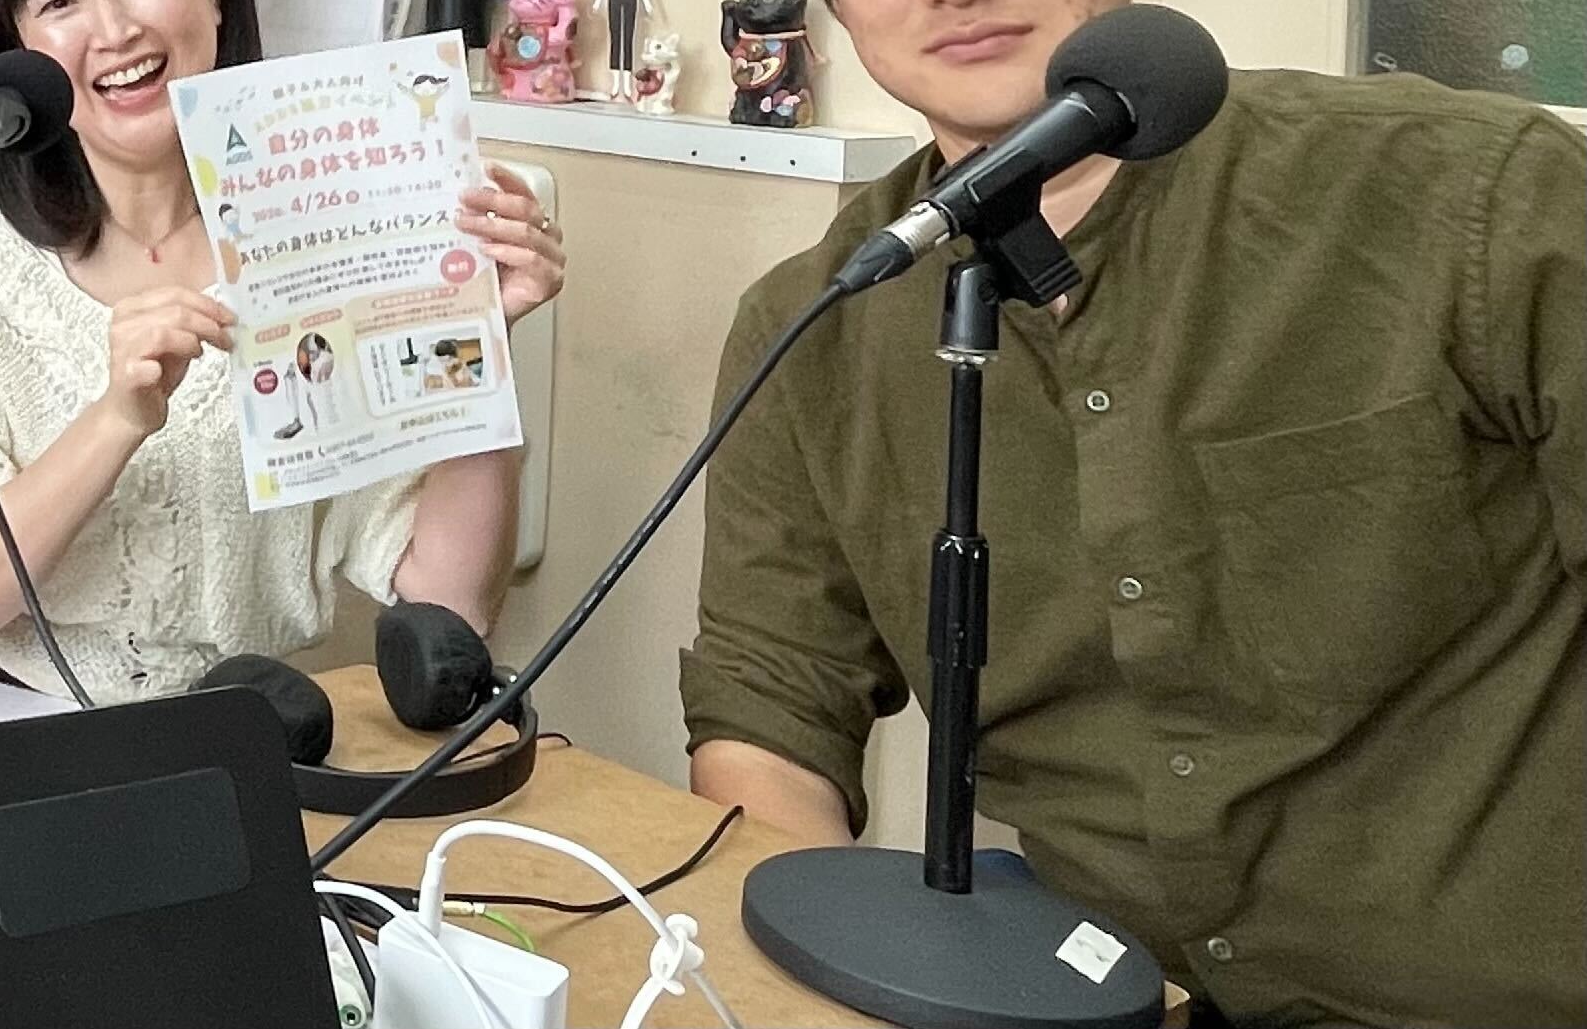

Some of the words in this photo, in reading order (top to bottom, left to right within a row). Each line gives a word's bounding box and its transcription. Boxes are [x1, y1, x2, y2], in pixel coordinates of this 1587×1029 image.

[269, 117, 380, 155] 自分の身体
